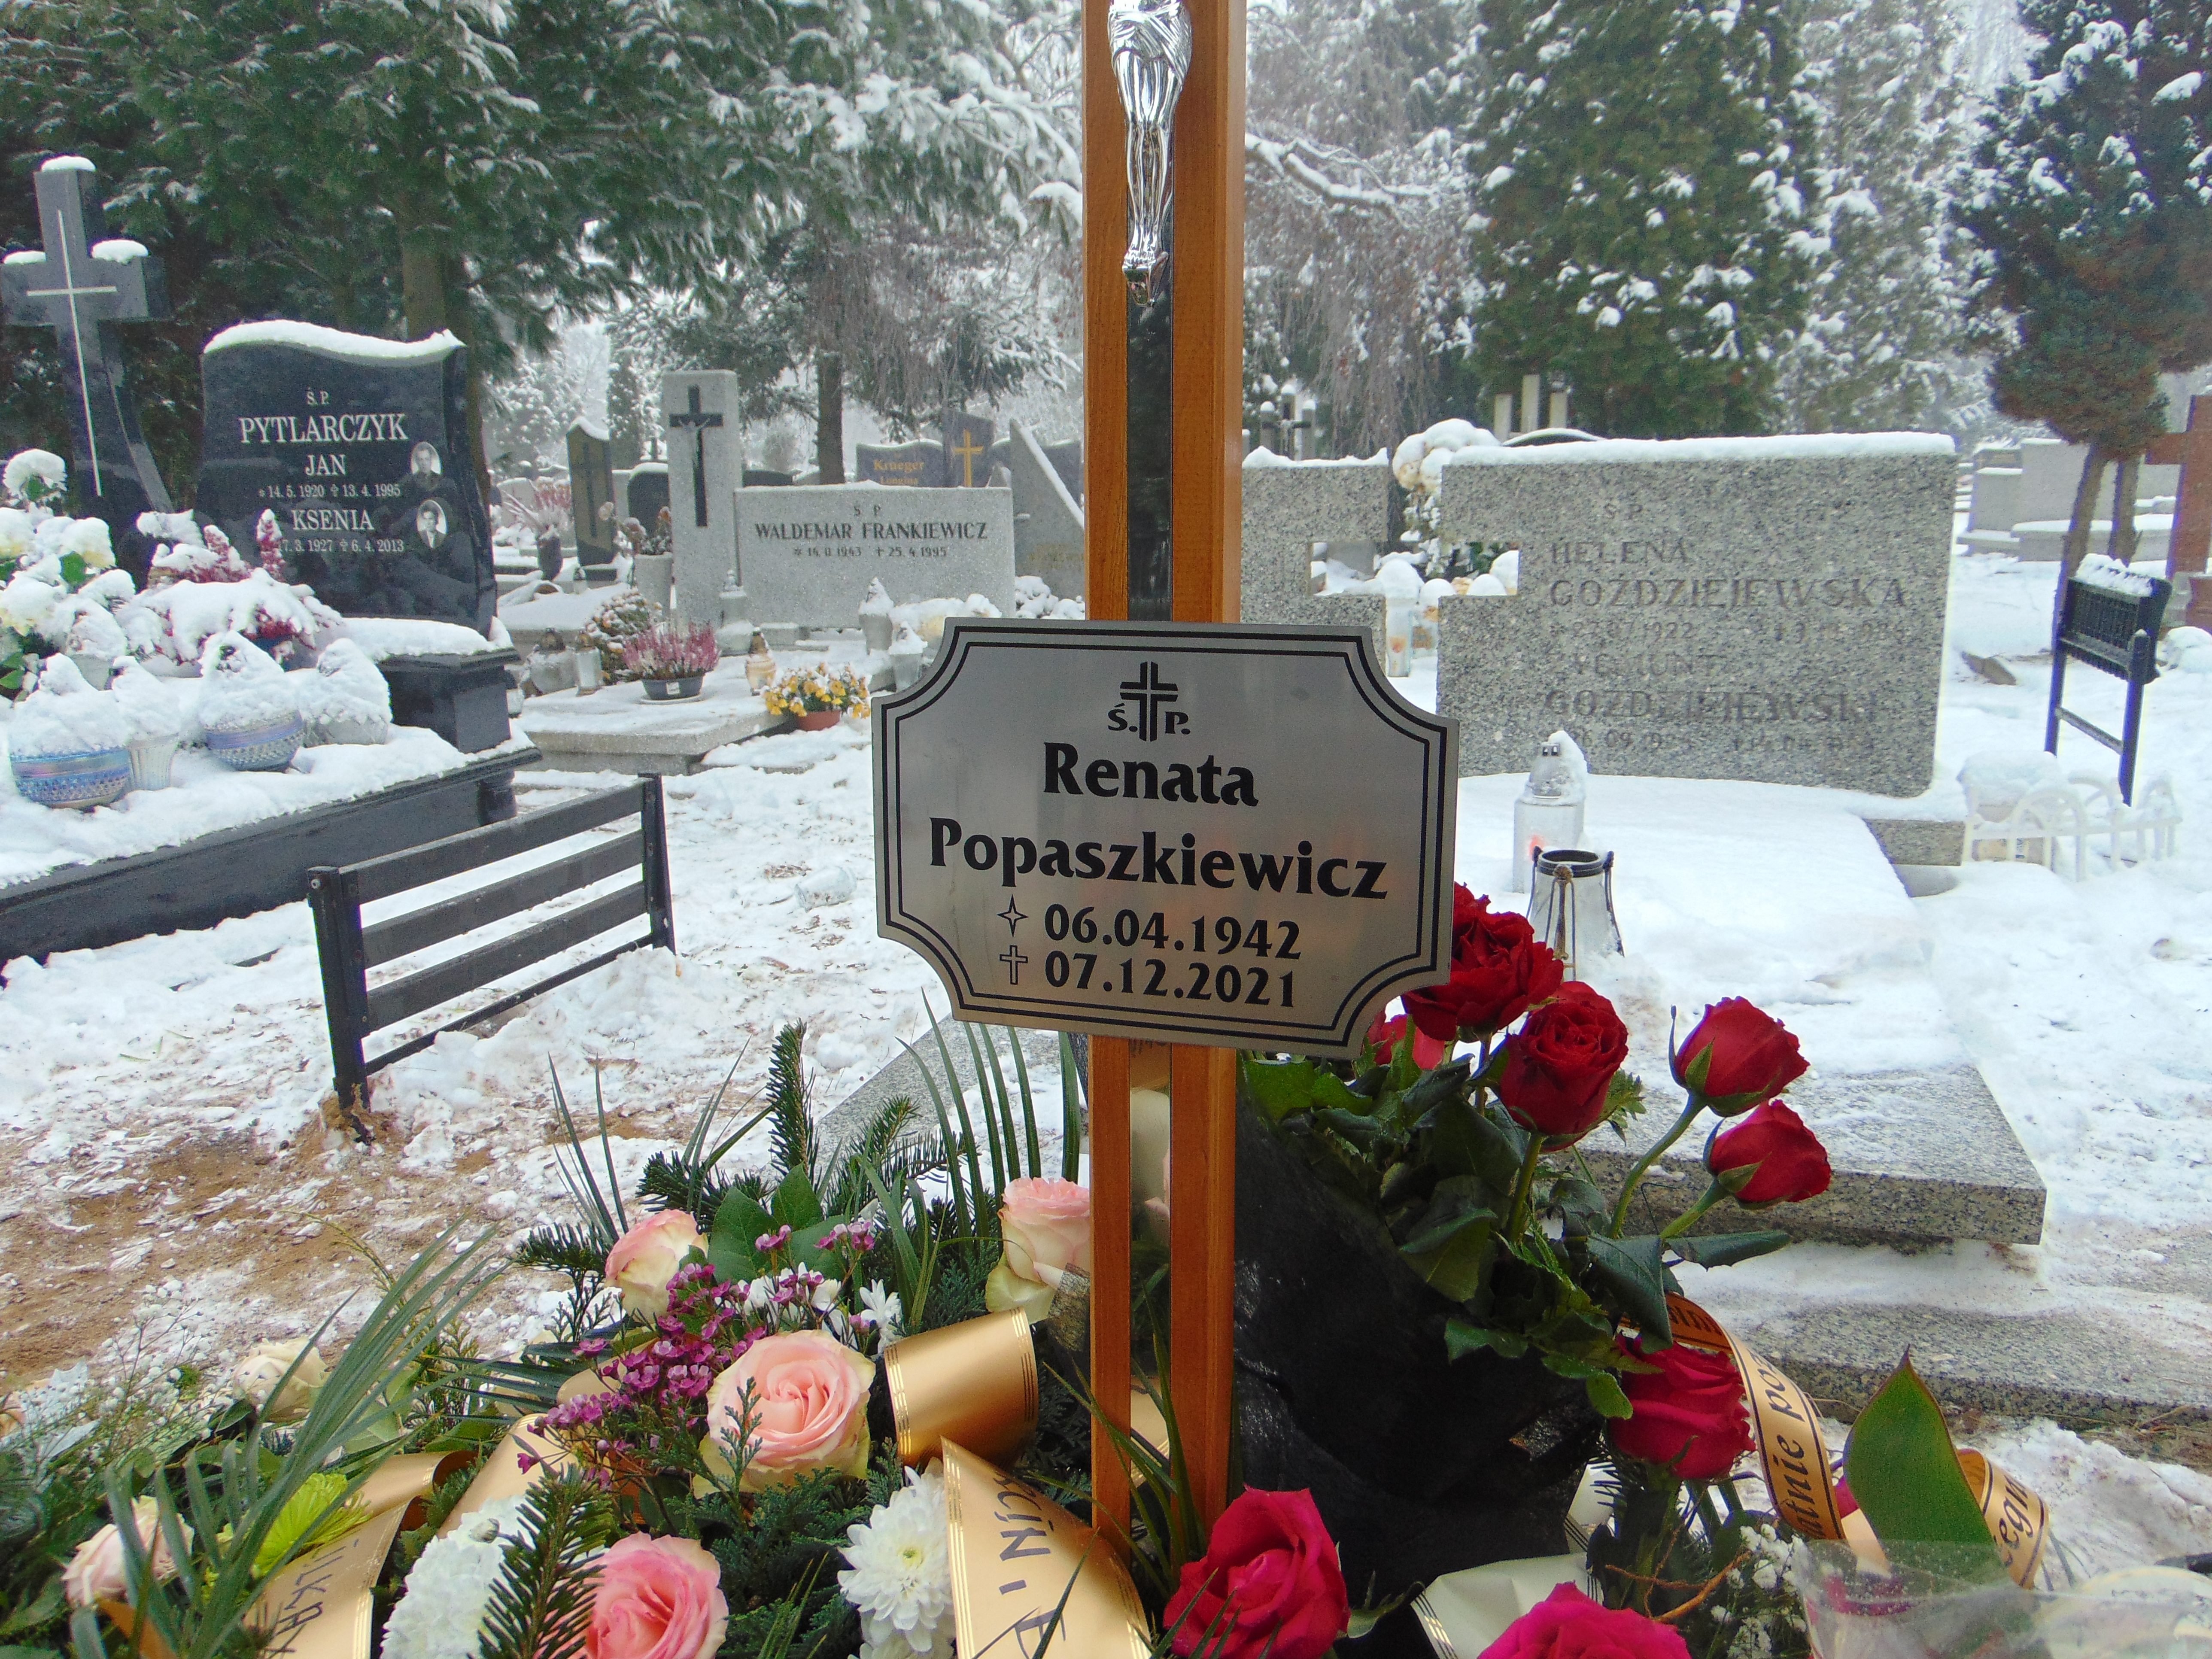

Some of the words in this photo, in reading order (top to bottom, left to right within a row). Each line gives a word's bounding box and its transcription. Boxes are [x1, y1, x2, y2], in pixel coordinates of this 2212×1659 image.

[238, 413, 409, 444] PYTLARCZYK
[305, 454, 346, 476] JAN
[374, 483, 401, 497] 1995
[291, 509, 375, 531] KSENIA
[755, 522, 852, 540] WALDEMAR
[862, 522, 989, 540] FRANKIEWICZ
[307, 539, 333, 552] 1927
[377, 539, 405, 552] 2013
[1550, 540, 1691, 564] HELENA
[1043, 741, 1258, 807] Renata
[929, 817, 1388, 899] Popaszkiewicz
[1045, 903, 1301, 960] 06.04.1942
[1045, 950, 1294, 1008] 07.12.2021
